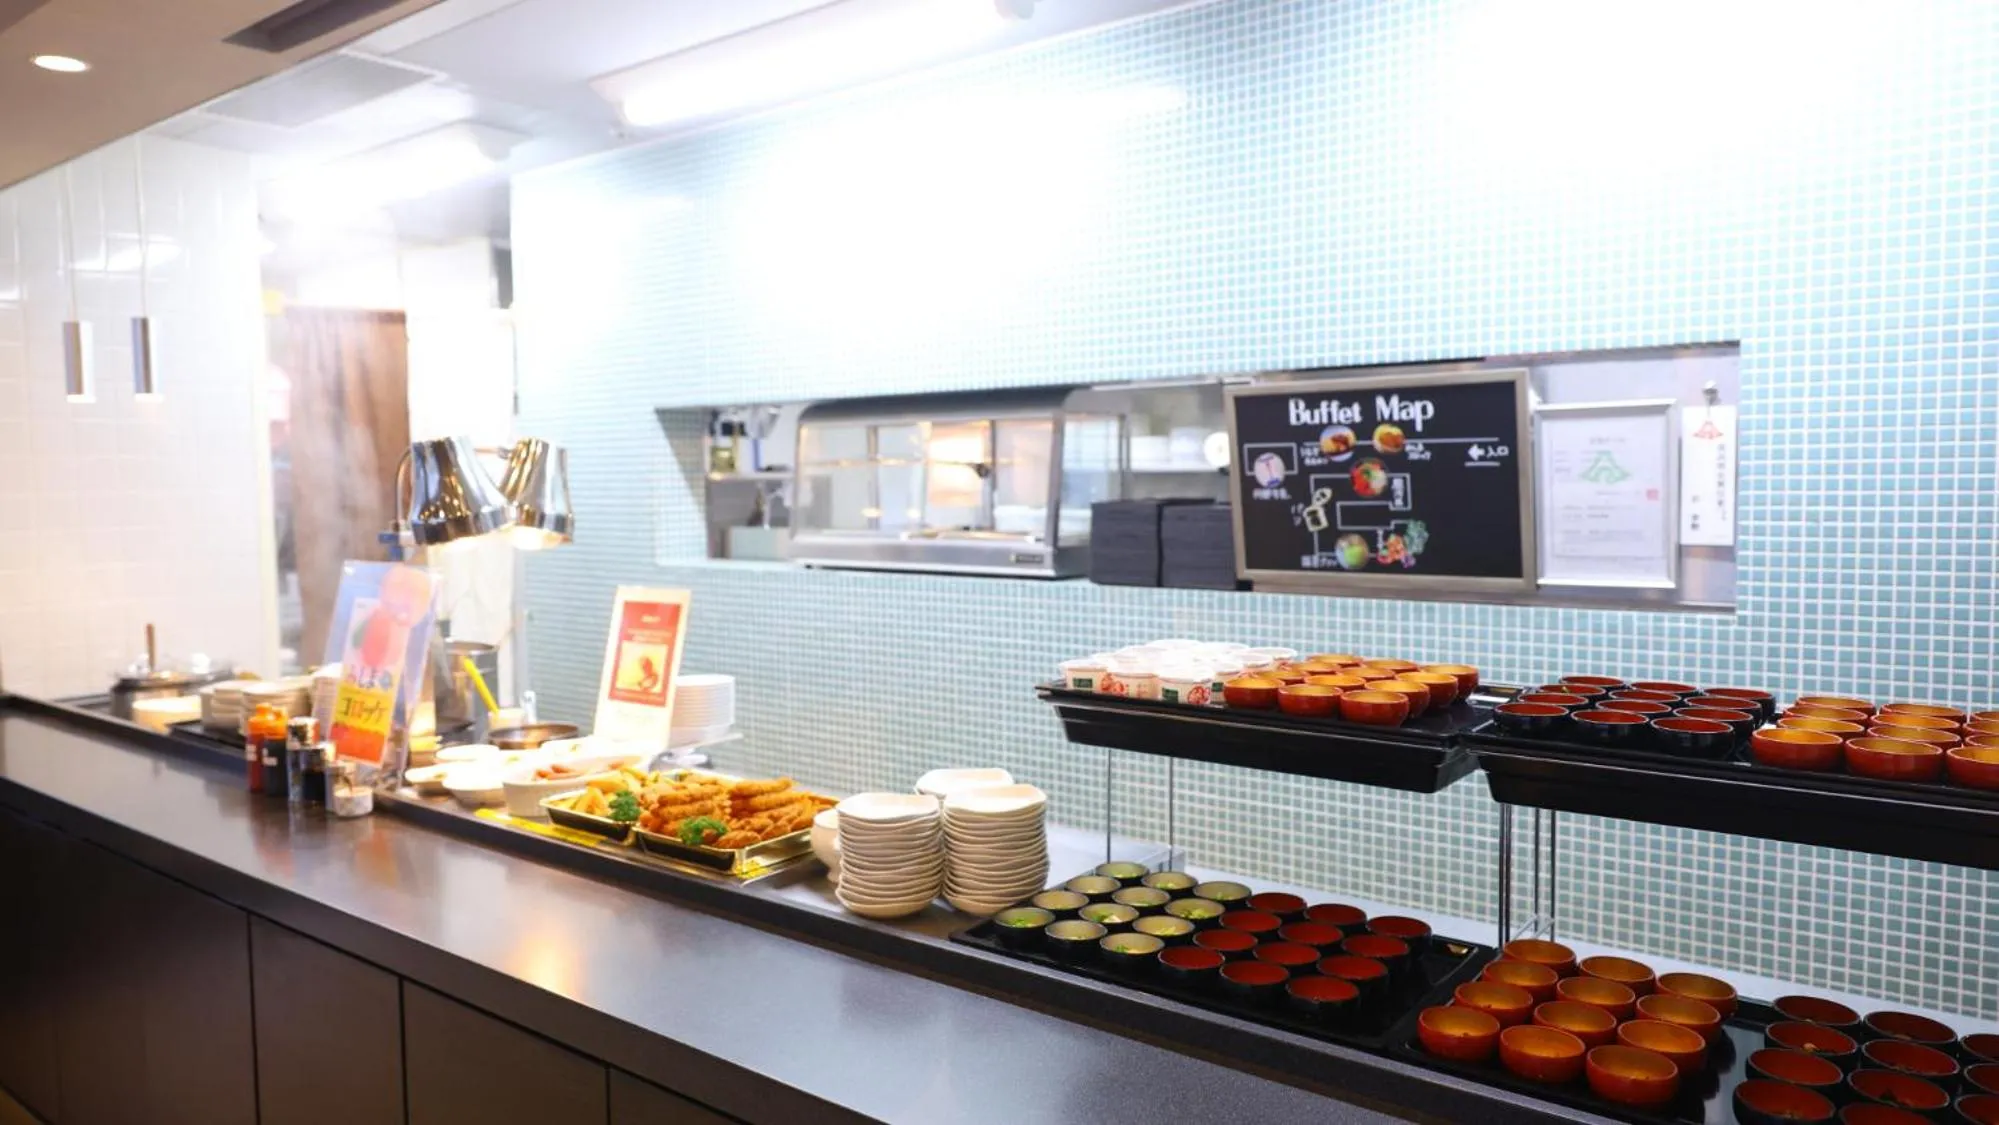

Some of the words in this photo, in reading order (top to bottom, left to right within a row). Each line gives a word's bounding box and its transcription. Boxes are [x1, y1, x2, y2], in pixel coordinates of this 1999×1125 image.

[1288, 397, 1362, 426] Buffet
[1375, 394, 1435, 432] Map
[1486, 445, 1510, 459] 入口
